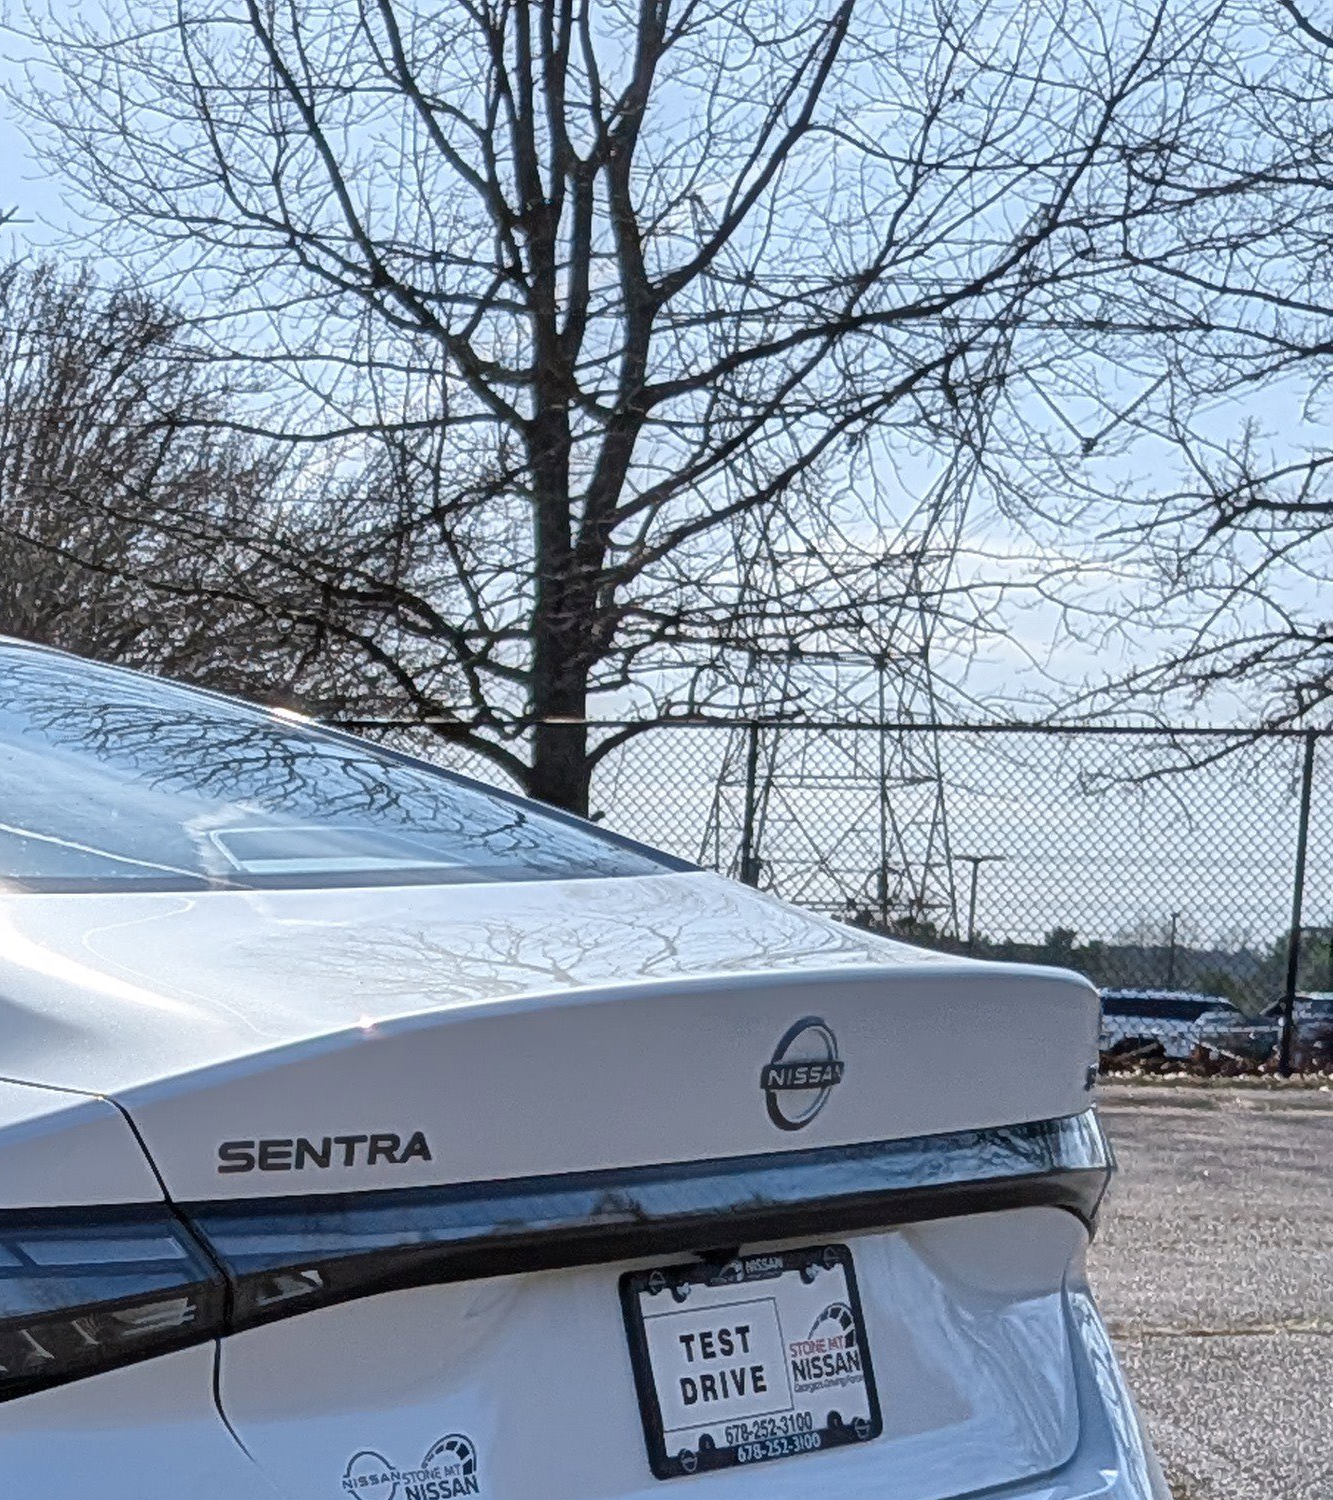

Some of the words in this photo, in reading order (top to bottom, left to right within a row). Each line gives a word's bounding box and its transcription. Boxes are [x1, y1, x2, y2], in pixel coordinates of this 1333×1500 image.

[767, 1064, 841, 1086] NISSAN
[217, 1131, 432, 1174] SENTRA
[679, 1324, 750, 1362] TEST
[789, 1338, 828, 1358] STONE
[791, 1349, 861, 1382] NISSAN
[679, 1365, 767, 1406] DRIVE
[724, 1411, 813, 1447] 678-252-3100
[737, 1432, 822, 1463] 678-252-3100
[342, 1471, 401, 1489] NISSAN
[402, 1466, 442, 1485] STONE
